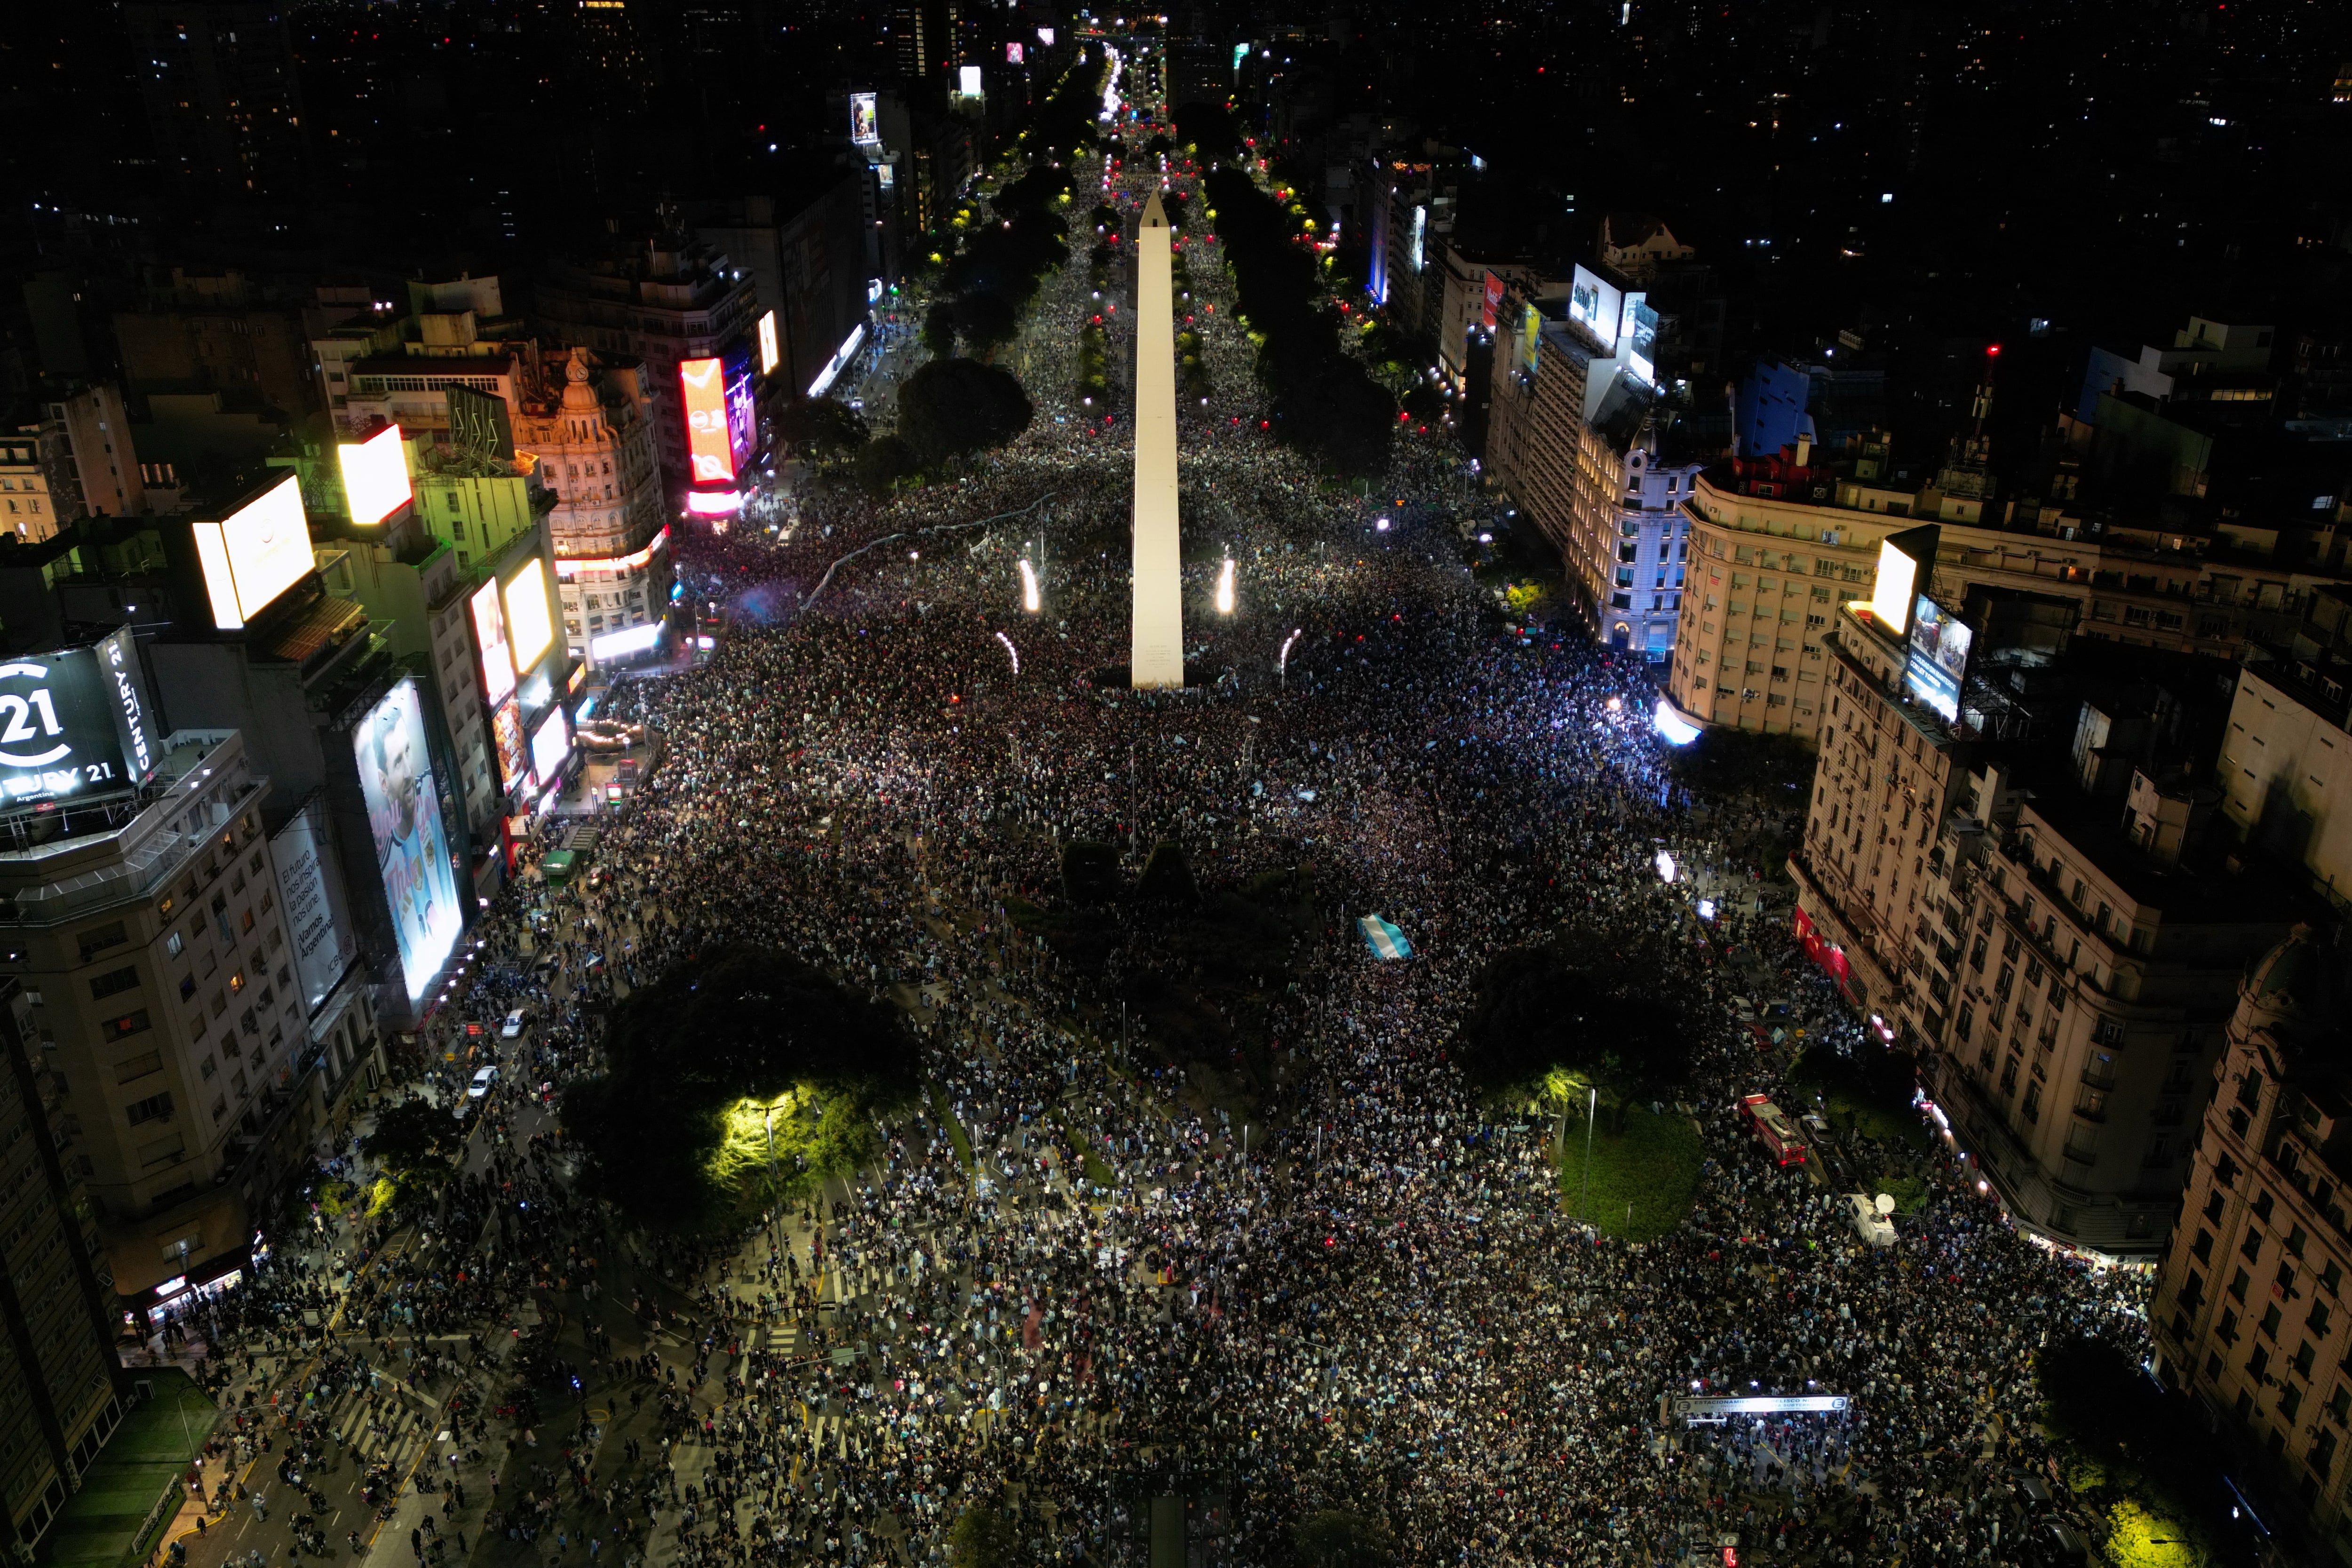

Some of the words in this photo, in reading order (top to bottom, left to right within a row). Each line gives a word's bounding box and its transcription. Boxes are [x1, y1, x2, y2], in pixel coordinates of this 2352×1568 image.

[1912, 652, 1917, 660] LA
[1916, 655, 1930, 669] CIUDAD
[1936, 670, 1956, 691] MANTEROS
[115, 671, 149, 771] CENTURY
[16, 792, 55, 802] Argentina
[282, 870, 289, 883] El
[289, 850, 310, 875] futuro
[286, 882, 300, 899] nos
[289, 898, 296, 913] la
[296, 876, 318, 906] pasión
[293, 911, 307, 927] nos
[297, 913, 323, 949] ¡Vamos
[301, 913, 334, 962] Argentina!
[327, 949, 344, 975] ICBC
[2019, 1223, 2047, 1237] Energizer
